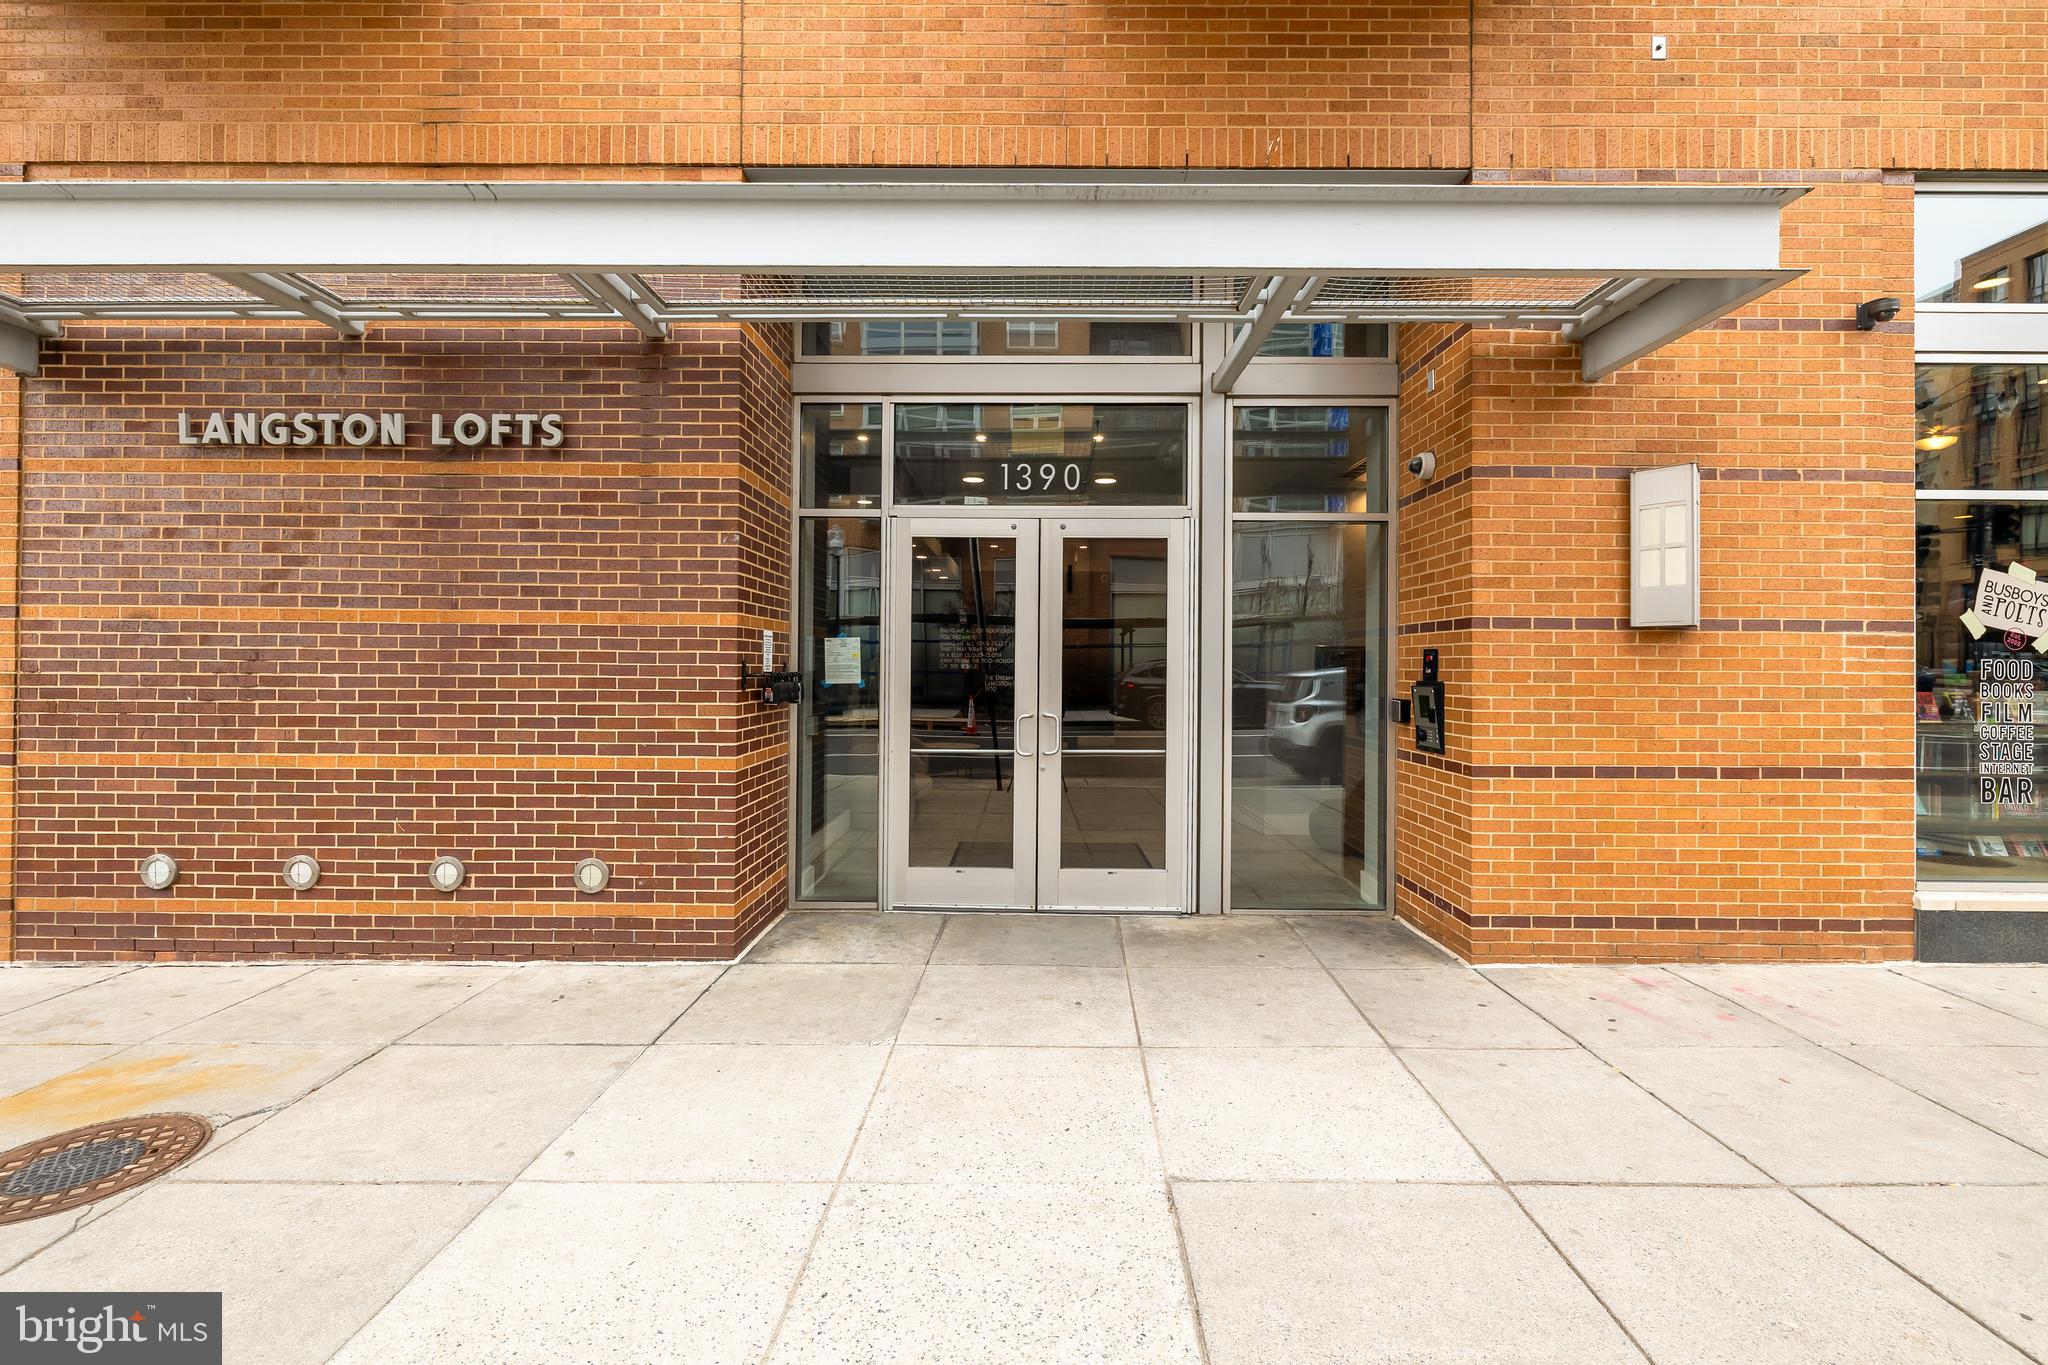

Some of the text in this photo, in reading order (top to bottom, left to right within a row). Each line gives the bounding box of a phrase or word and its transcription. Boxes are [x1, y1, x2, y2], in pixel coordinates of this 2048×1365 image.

[178, 412, 564, 448] LANGSTON LOFTS
[1000, 463, 1080, 491] 1390
[1984, 580, 2048, 607] BUSBOYS
[1981, 594, 1994, 615] AND
[1993, 597, 2047, 627] POETS
[2006, 637, 2022, 647] 2005
[1980, 659, 2034, 680] FOOD
[1979, 682, 2034, 699] BOOKS
[1980, 702, 2034, 723] FILM
[1979, 724, 2034, 740] COFFEE
[1979, 742, 2034, 760] STAGE
[1979, 762, 2034, 775] INTERNET
[1980, 776, 2033, 804] BAR
